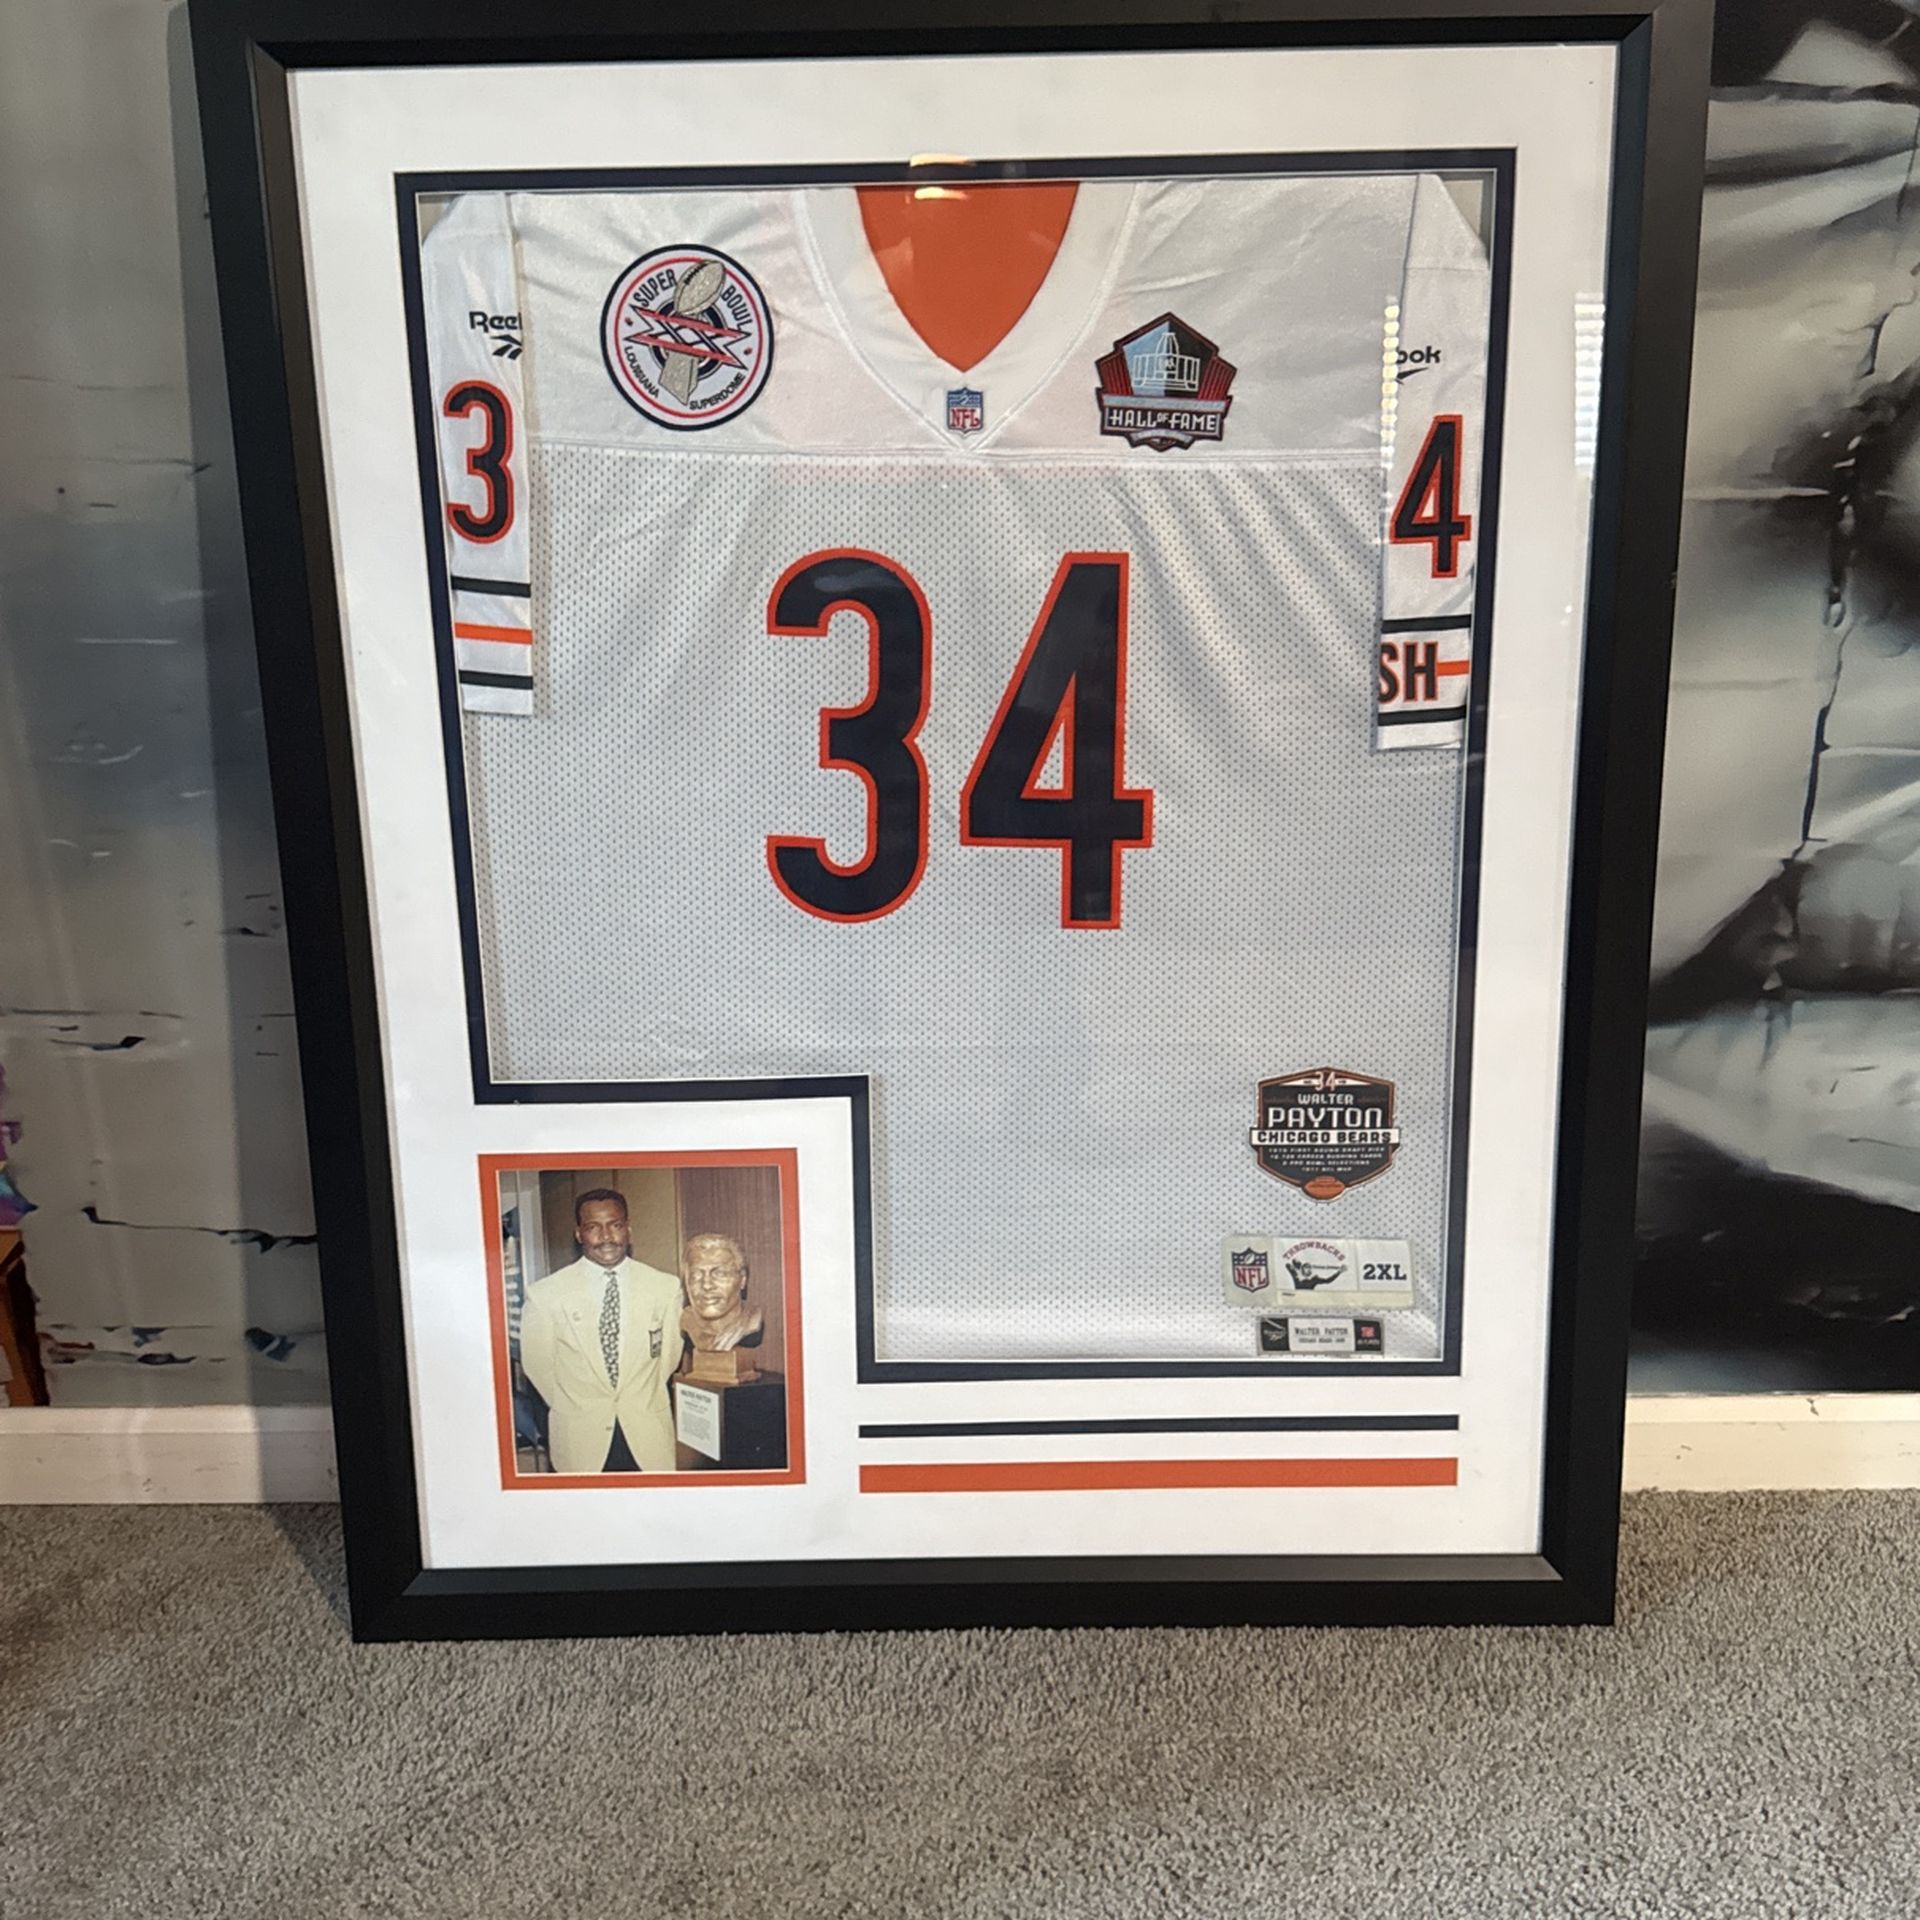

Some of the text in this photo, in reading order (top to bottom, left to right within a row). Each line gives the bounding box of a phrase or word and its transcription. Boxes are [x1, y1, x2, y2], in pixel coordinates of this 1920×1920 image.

[633, 268, 753, 331] SUPER BOWL
[469, 311, 523, 333] Ree
[623, 345, 661, 398] LOUISIANA
[689, 372, 747, 411] SUPERDOME
[951, 408, 981, 428] NFL
[1110, 409, 1217, 431] HALL OF FAME
[443, 380, 515, 544] 3
[1389, 414, 1472, 578] 4
[767, 547, 1155, 930] 34
[1314, 1071, 1336, 1091] 34
[1297, 1093, 1354, 1105] WALTER
[1268, 1107, 1383, 1128] PAYTON
[1257, 1131, 1392, 1143] CHICAGO BEARS
[1281, 1240, 1346, 1262] THROWBACKS
[1235, 1266, 1267, 1286] NFL
[1363, 1263, 1407, 1281] 2XL
